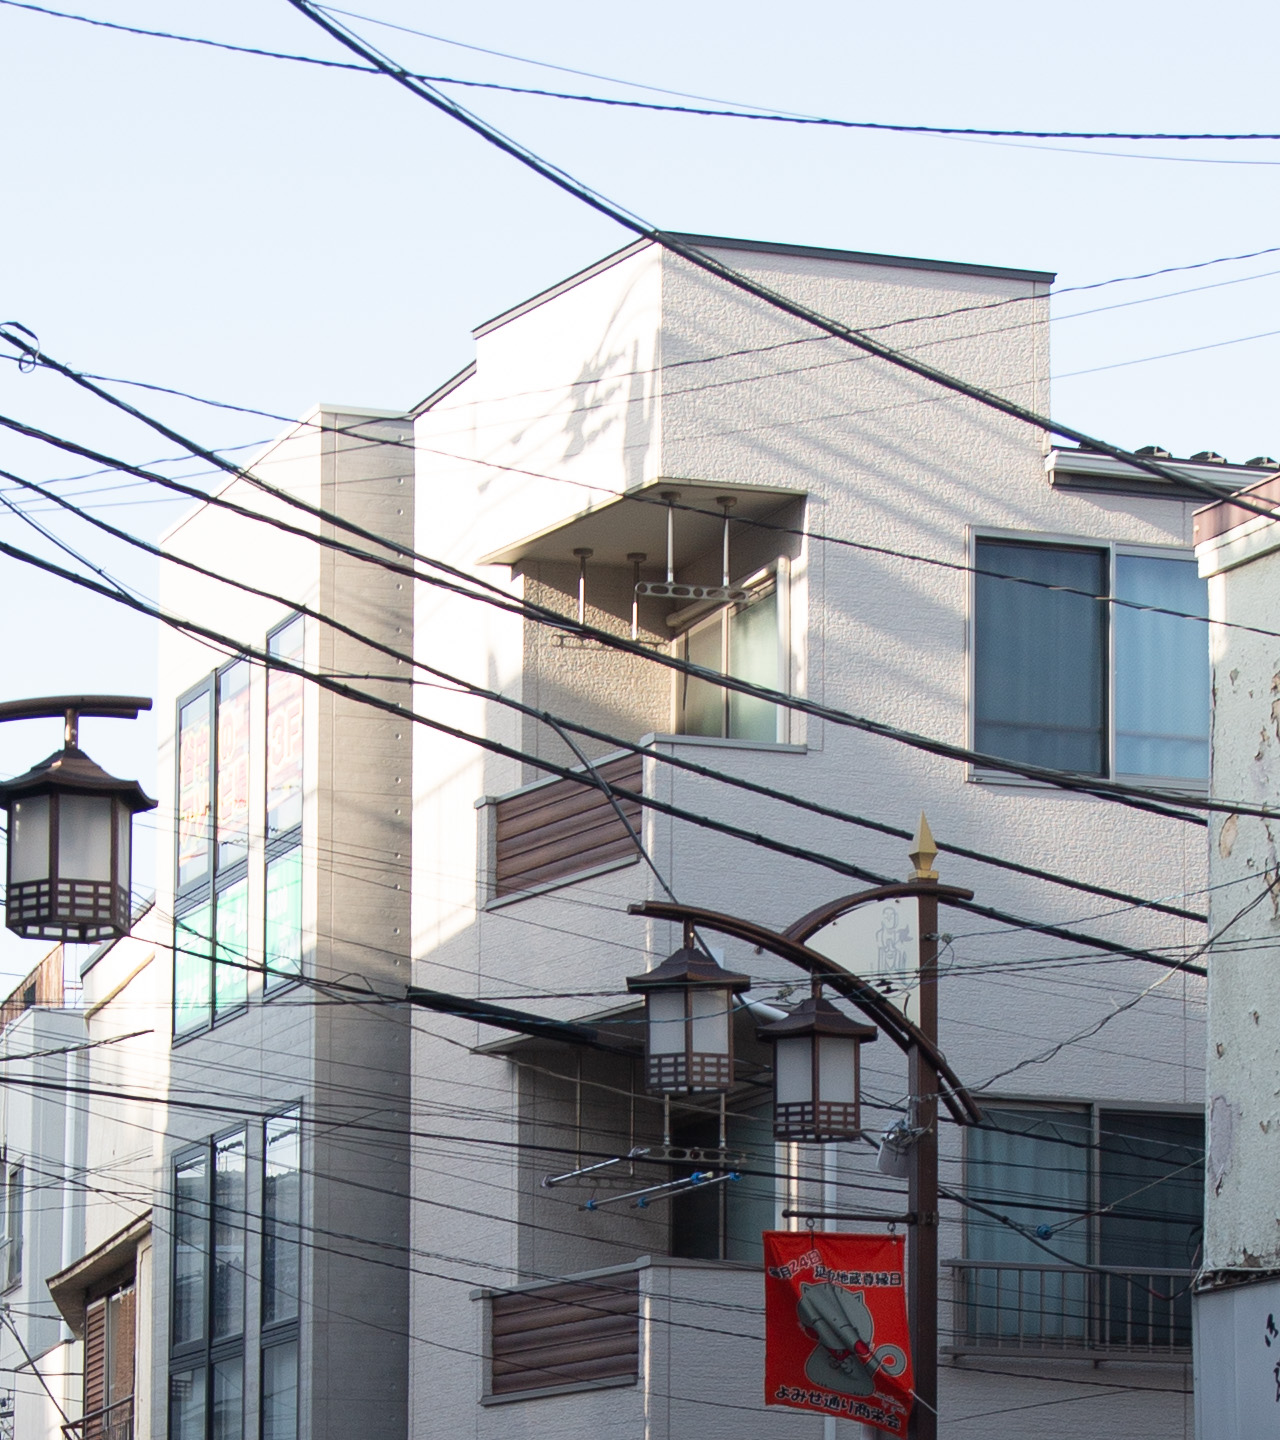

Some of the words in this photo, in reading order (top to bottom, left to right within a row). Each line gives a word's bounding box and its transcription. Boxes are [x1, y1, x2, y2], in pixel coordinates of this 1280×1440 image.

[774, 1385, 902, 1430] よみせ通り商栄会
